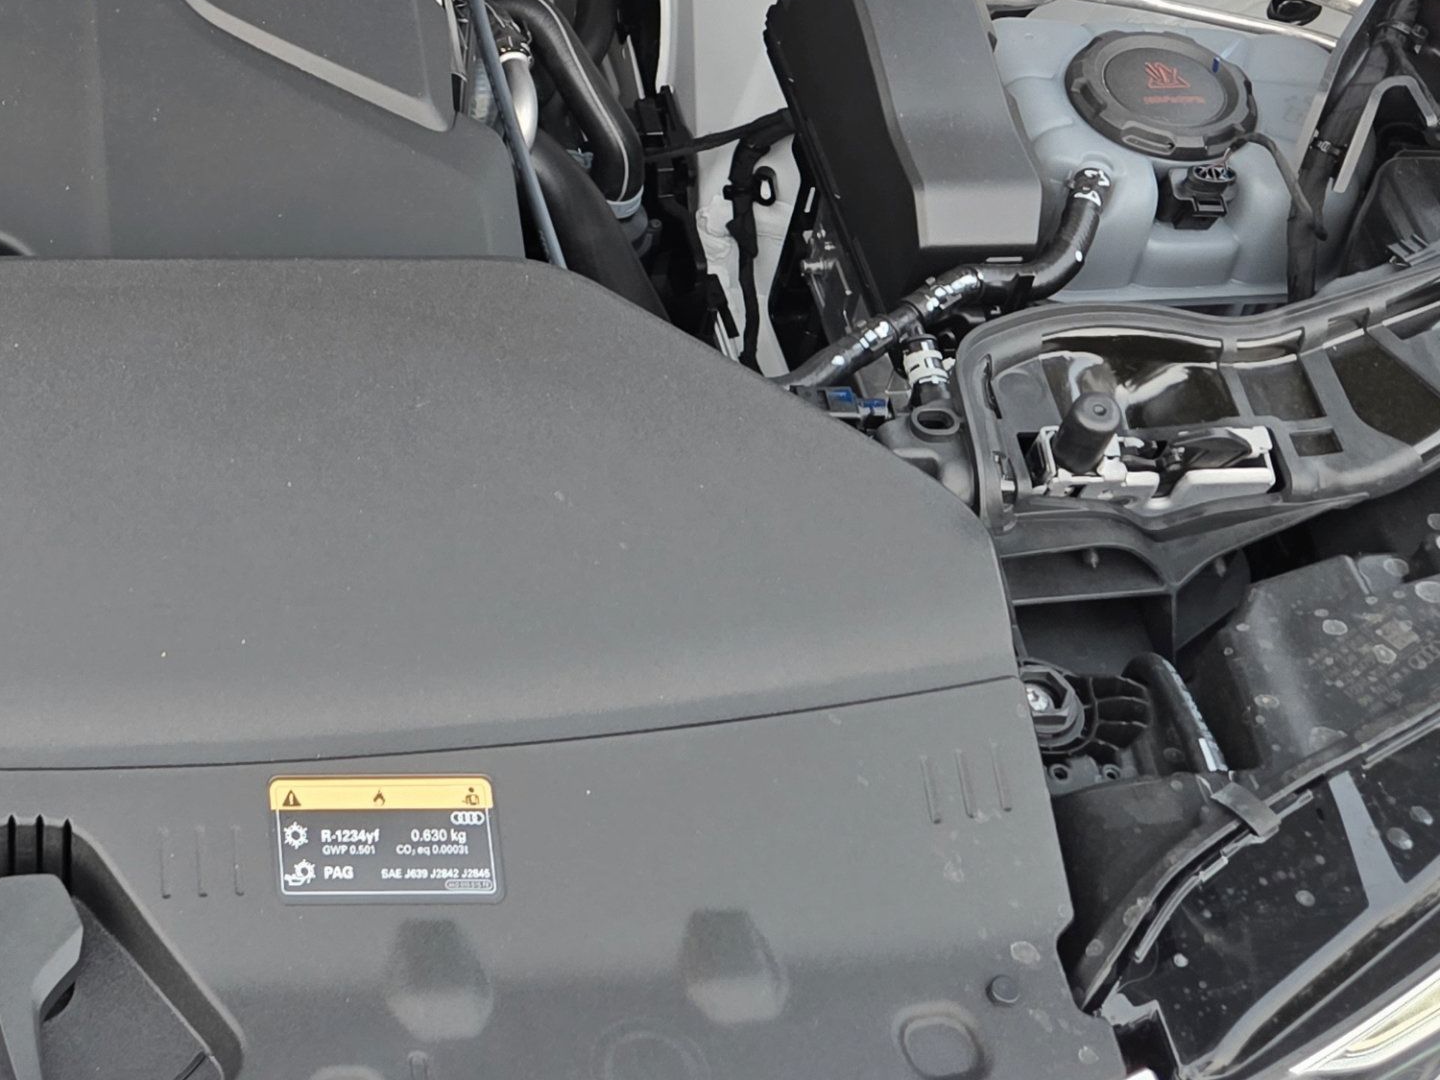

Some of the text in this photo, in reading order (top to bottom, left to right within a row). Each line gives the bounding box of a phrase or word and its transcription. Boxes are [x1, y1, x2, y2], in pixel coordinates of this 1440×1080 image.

[320, 828, 380, 845] R-1234yf
[410, 828, 468, 844] 0.630 kg
[322, 844, 376, 856] GWP 0.501
[417, 846, 431, 857] eq
[323, 865, 354, 880] PAG
[381, 868, 402, 879] SAE
[404, 868, 429, 880] J639
[430, 868, 460, 879] J2842
